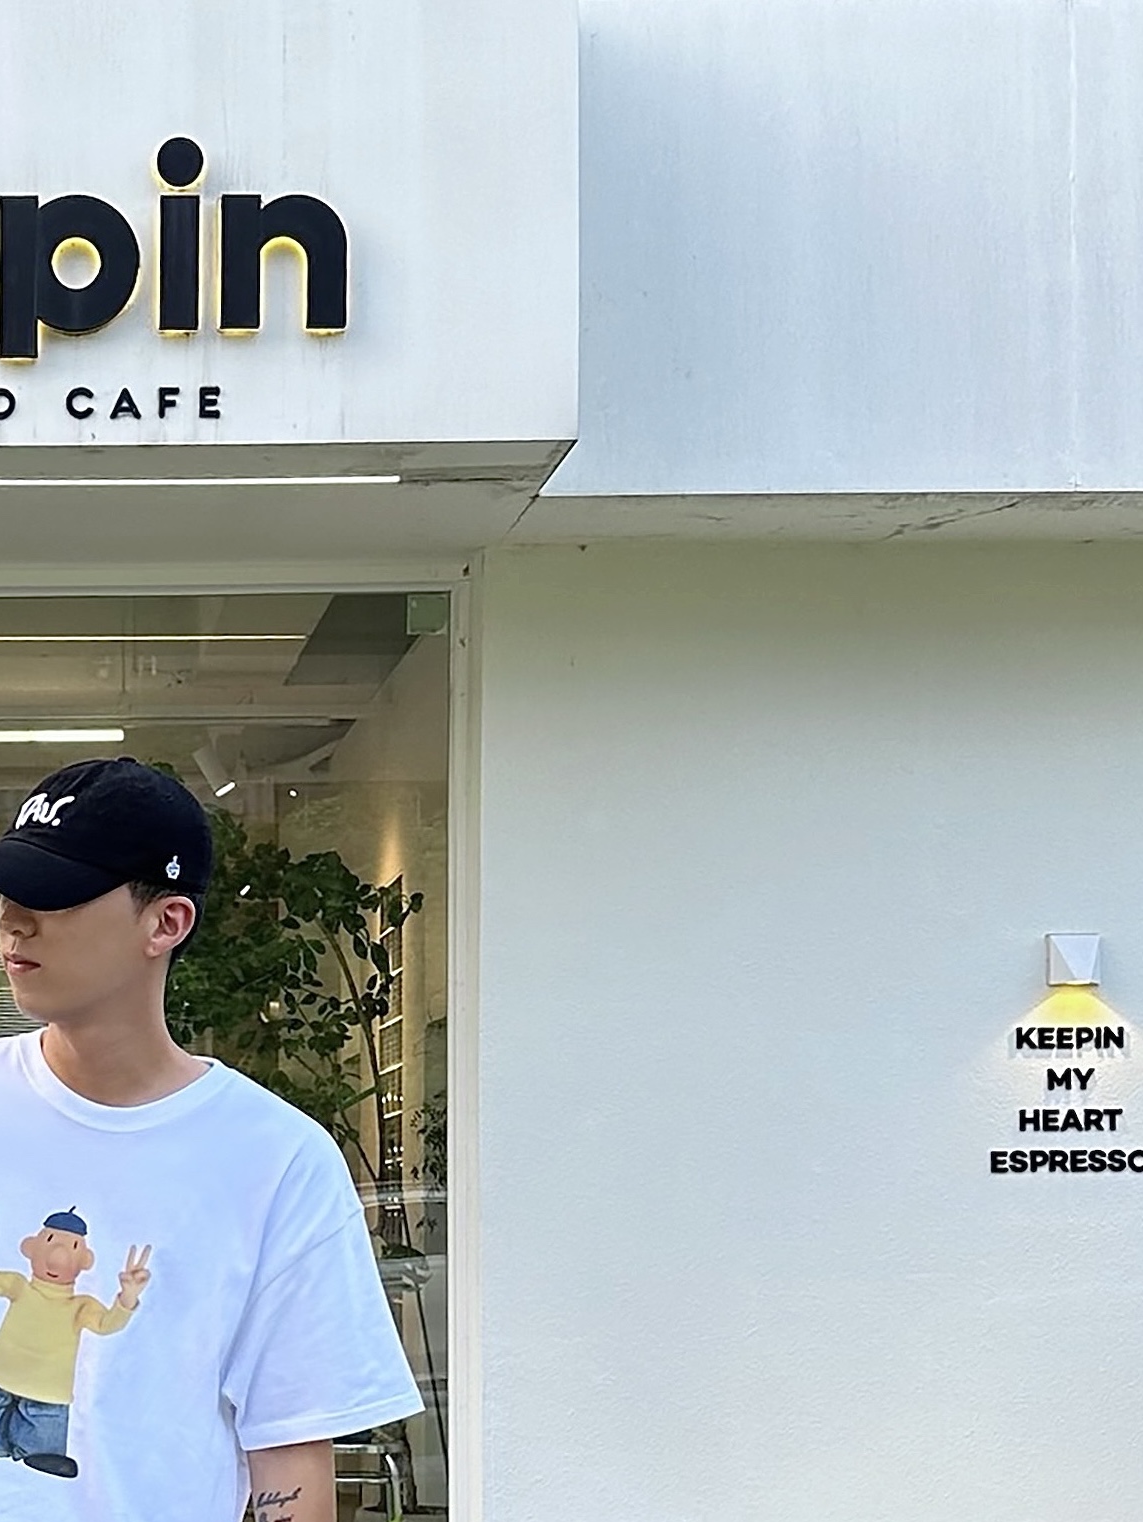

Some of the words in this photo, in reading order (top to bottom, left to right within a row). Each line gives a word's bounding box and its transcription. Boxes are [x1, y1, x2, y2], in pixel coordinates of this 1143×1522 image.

[65, 386, 222, 420] CAFE
[1015, 1026, 1125, 1050] KEEPIN
[1046, 1067, 1095, 1091] MY
[1018, 1108, 1124, 1132] HEART
[989, 1149, 1143, 1174] ESPRESSO
